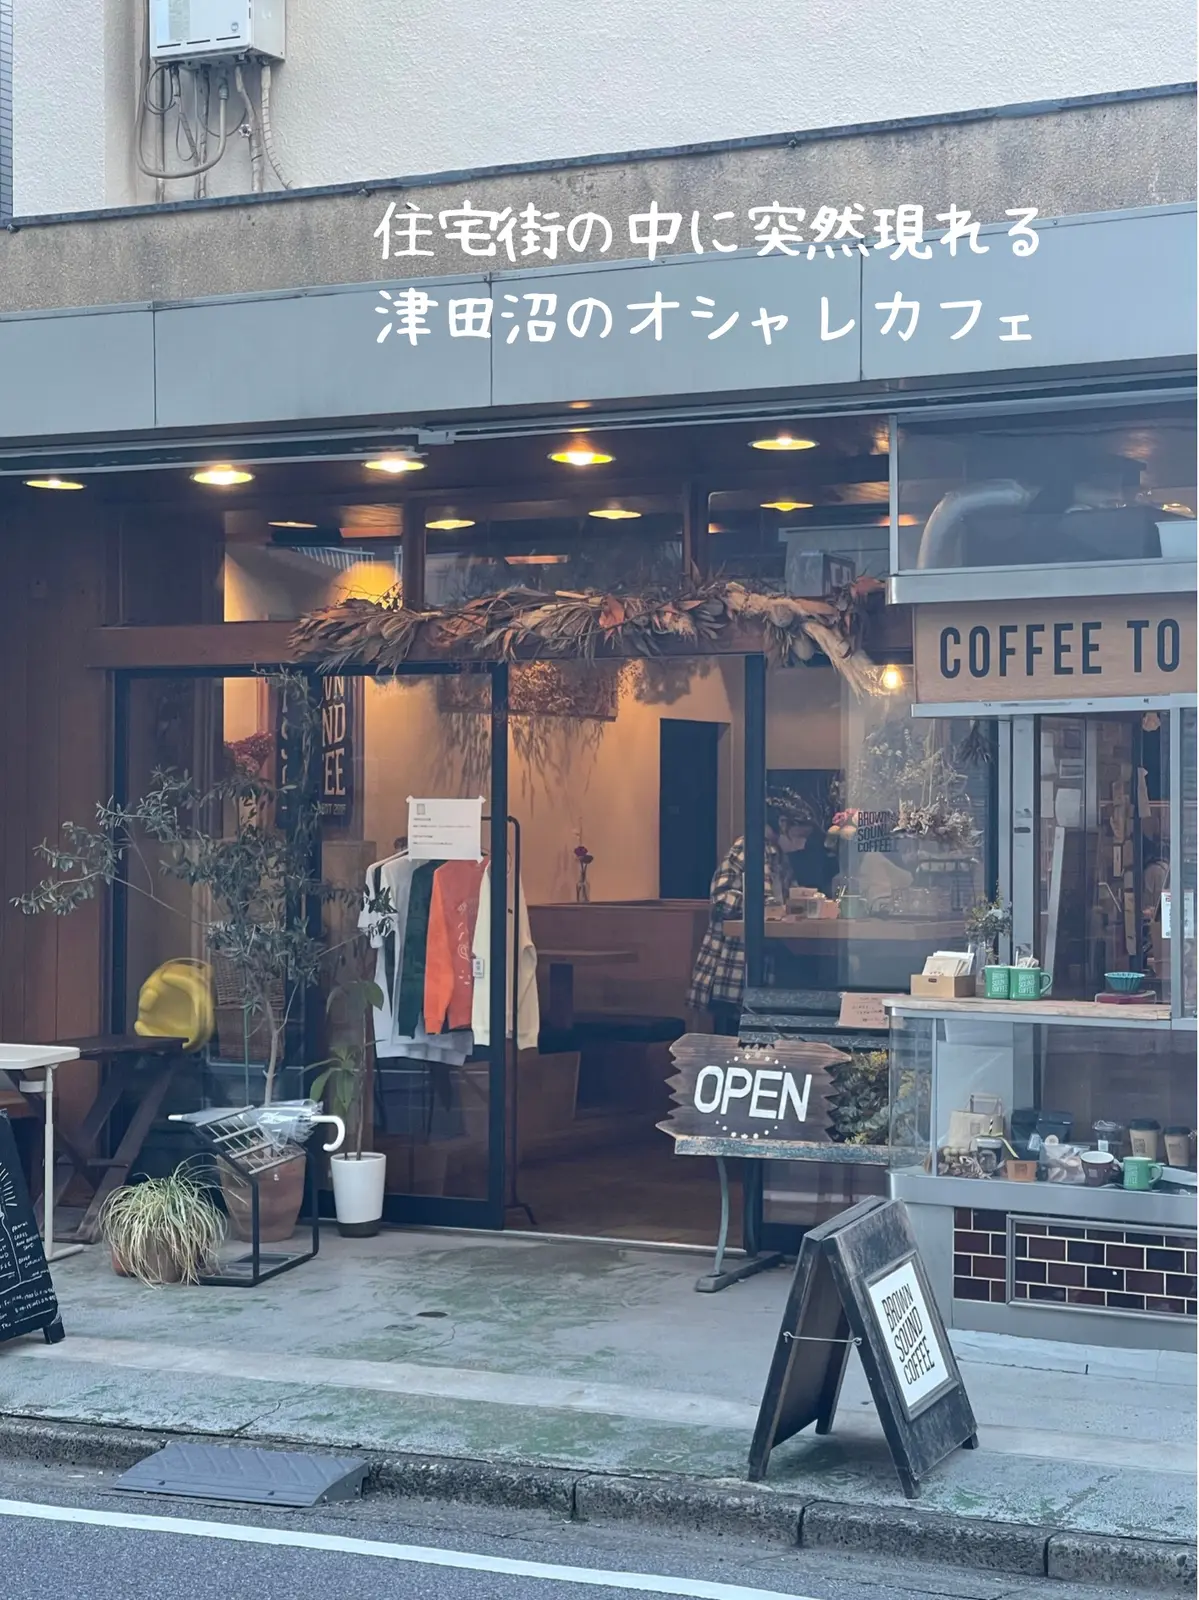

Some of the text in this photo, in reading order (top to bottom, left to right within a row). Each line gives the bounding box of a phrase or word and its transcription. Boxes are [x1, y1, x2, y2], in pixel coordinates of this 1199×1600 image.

[940, 618, 1180, 679] COFFEE TO
[694, 1065, 812, 1122] OPEN
[881, 1283, 914, 1333] BROWN
[894, 1306, 923, 1363] SOUND
[903, 1335, 935, 1385] COFFEE
